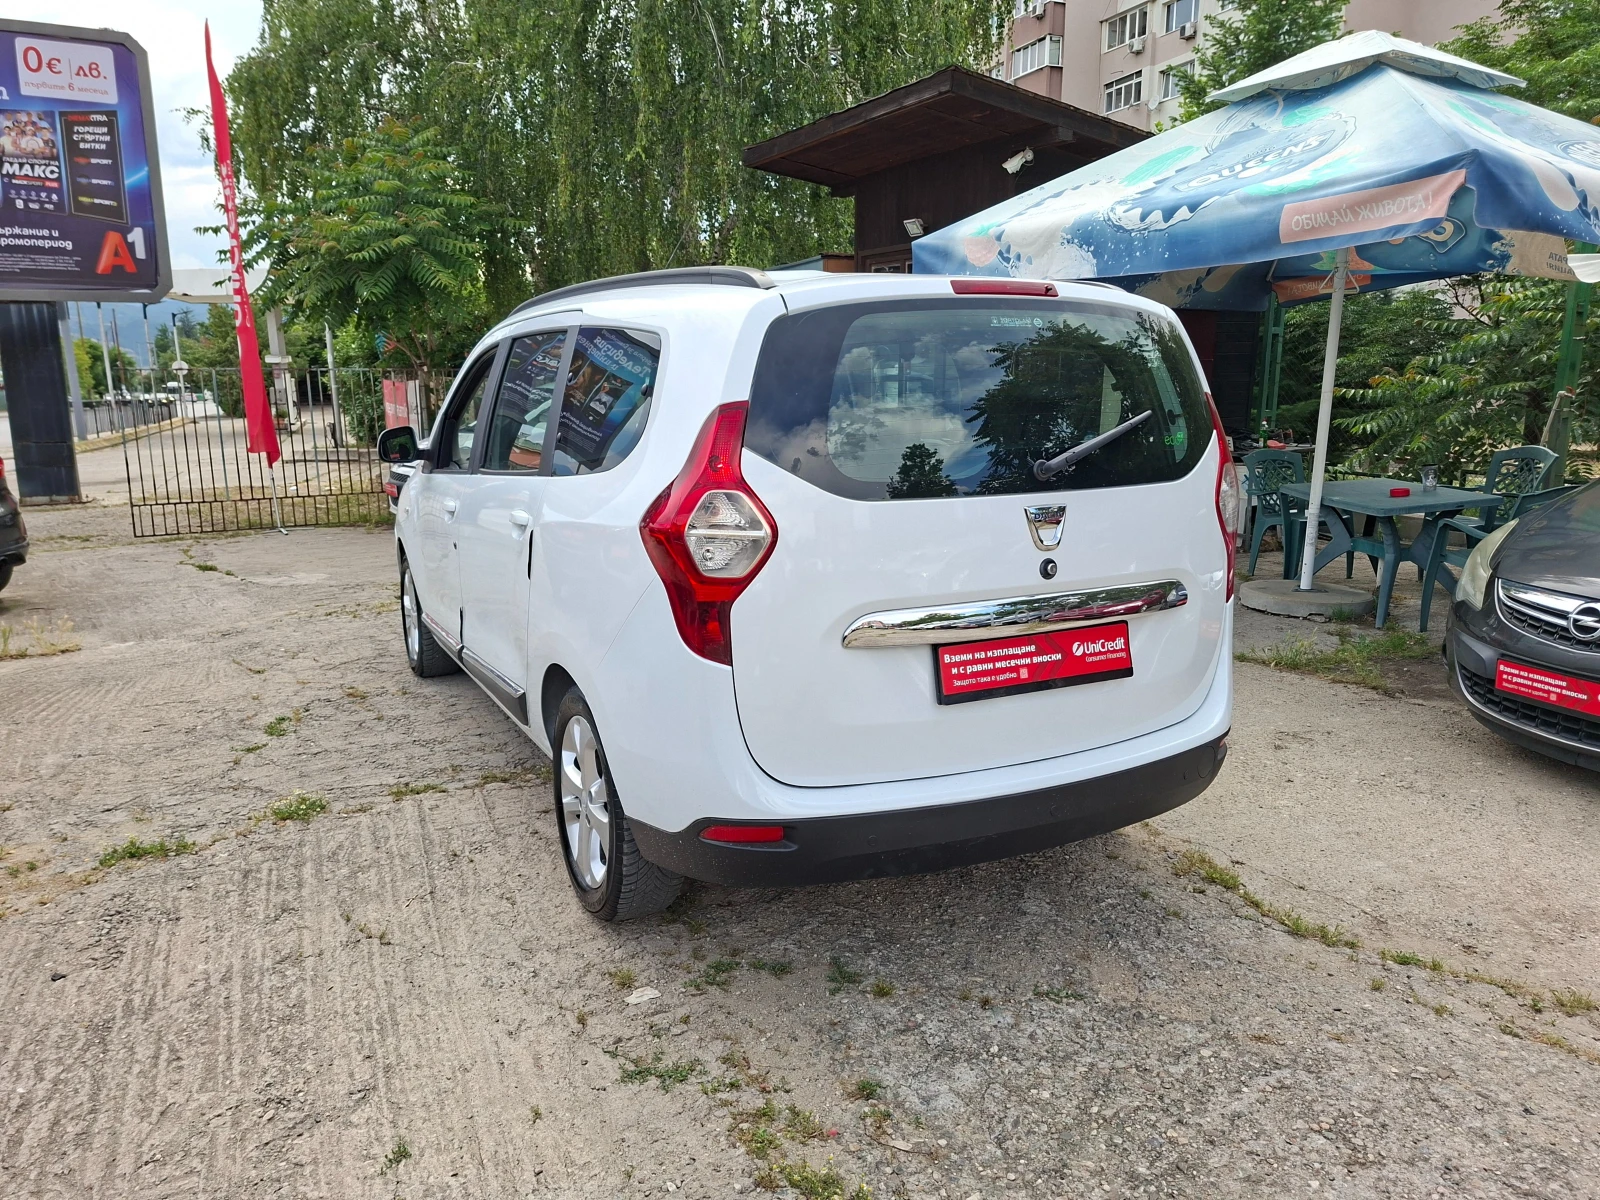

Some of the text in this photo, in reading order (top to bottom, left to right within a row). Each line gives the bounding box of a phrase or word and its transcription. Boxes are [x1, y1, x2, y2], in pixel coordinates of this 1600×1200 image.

[75, 62, 107, 80] лв.
[24, 81, 109, 96] първите 6 месеца
[73, 126, 108, 134] ГОРЕЩИ
[79, 142, 106, 150] БИТКИ
[1186, 135, 1325, 188] QUEENS
[1, 162, 60, 179] МАКС
[1291, 192, 1433, 231] ОБИЧАЙ ЖИВОТА!
[51, 229, 59, 237] и
[0, 237, 73, 251] ромопериод
[96, 226, 146, 275] A1
[944, 644, 1036, 664] Вземи на изплащане
[1083, 637, 1125, 654] UniCredit
[951, 652, 1062, 675] и с равни месечни вноски
[1085, 654, 1107, 663] Consumer
[953, 678, 977, 687] Защото
[996, 672, 1017, 682] удобно
[1499, 664, 1567, 687] Вземи на изплащане
[1512, 676, 1532, 686] равни
[1532, 681, 1562, 693] месечни
[1561, 689, 1588, 700] вноски
